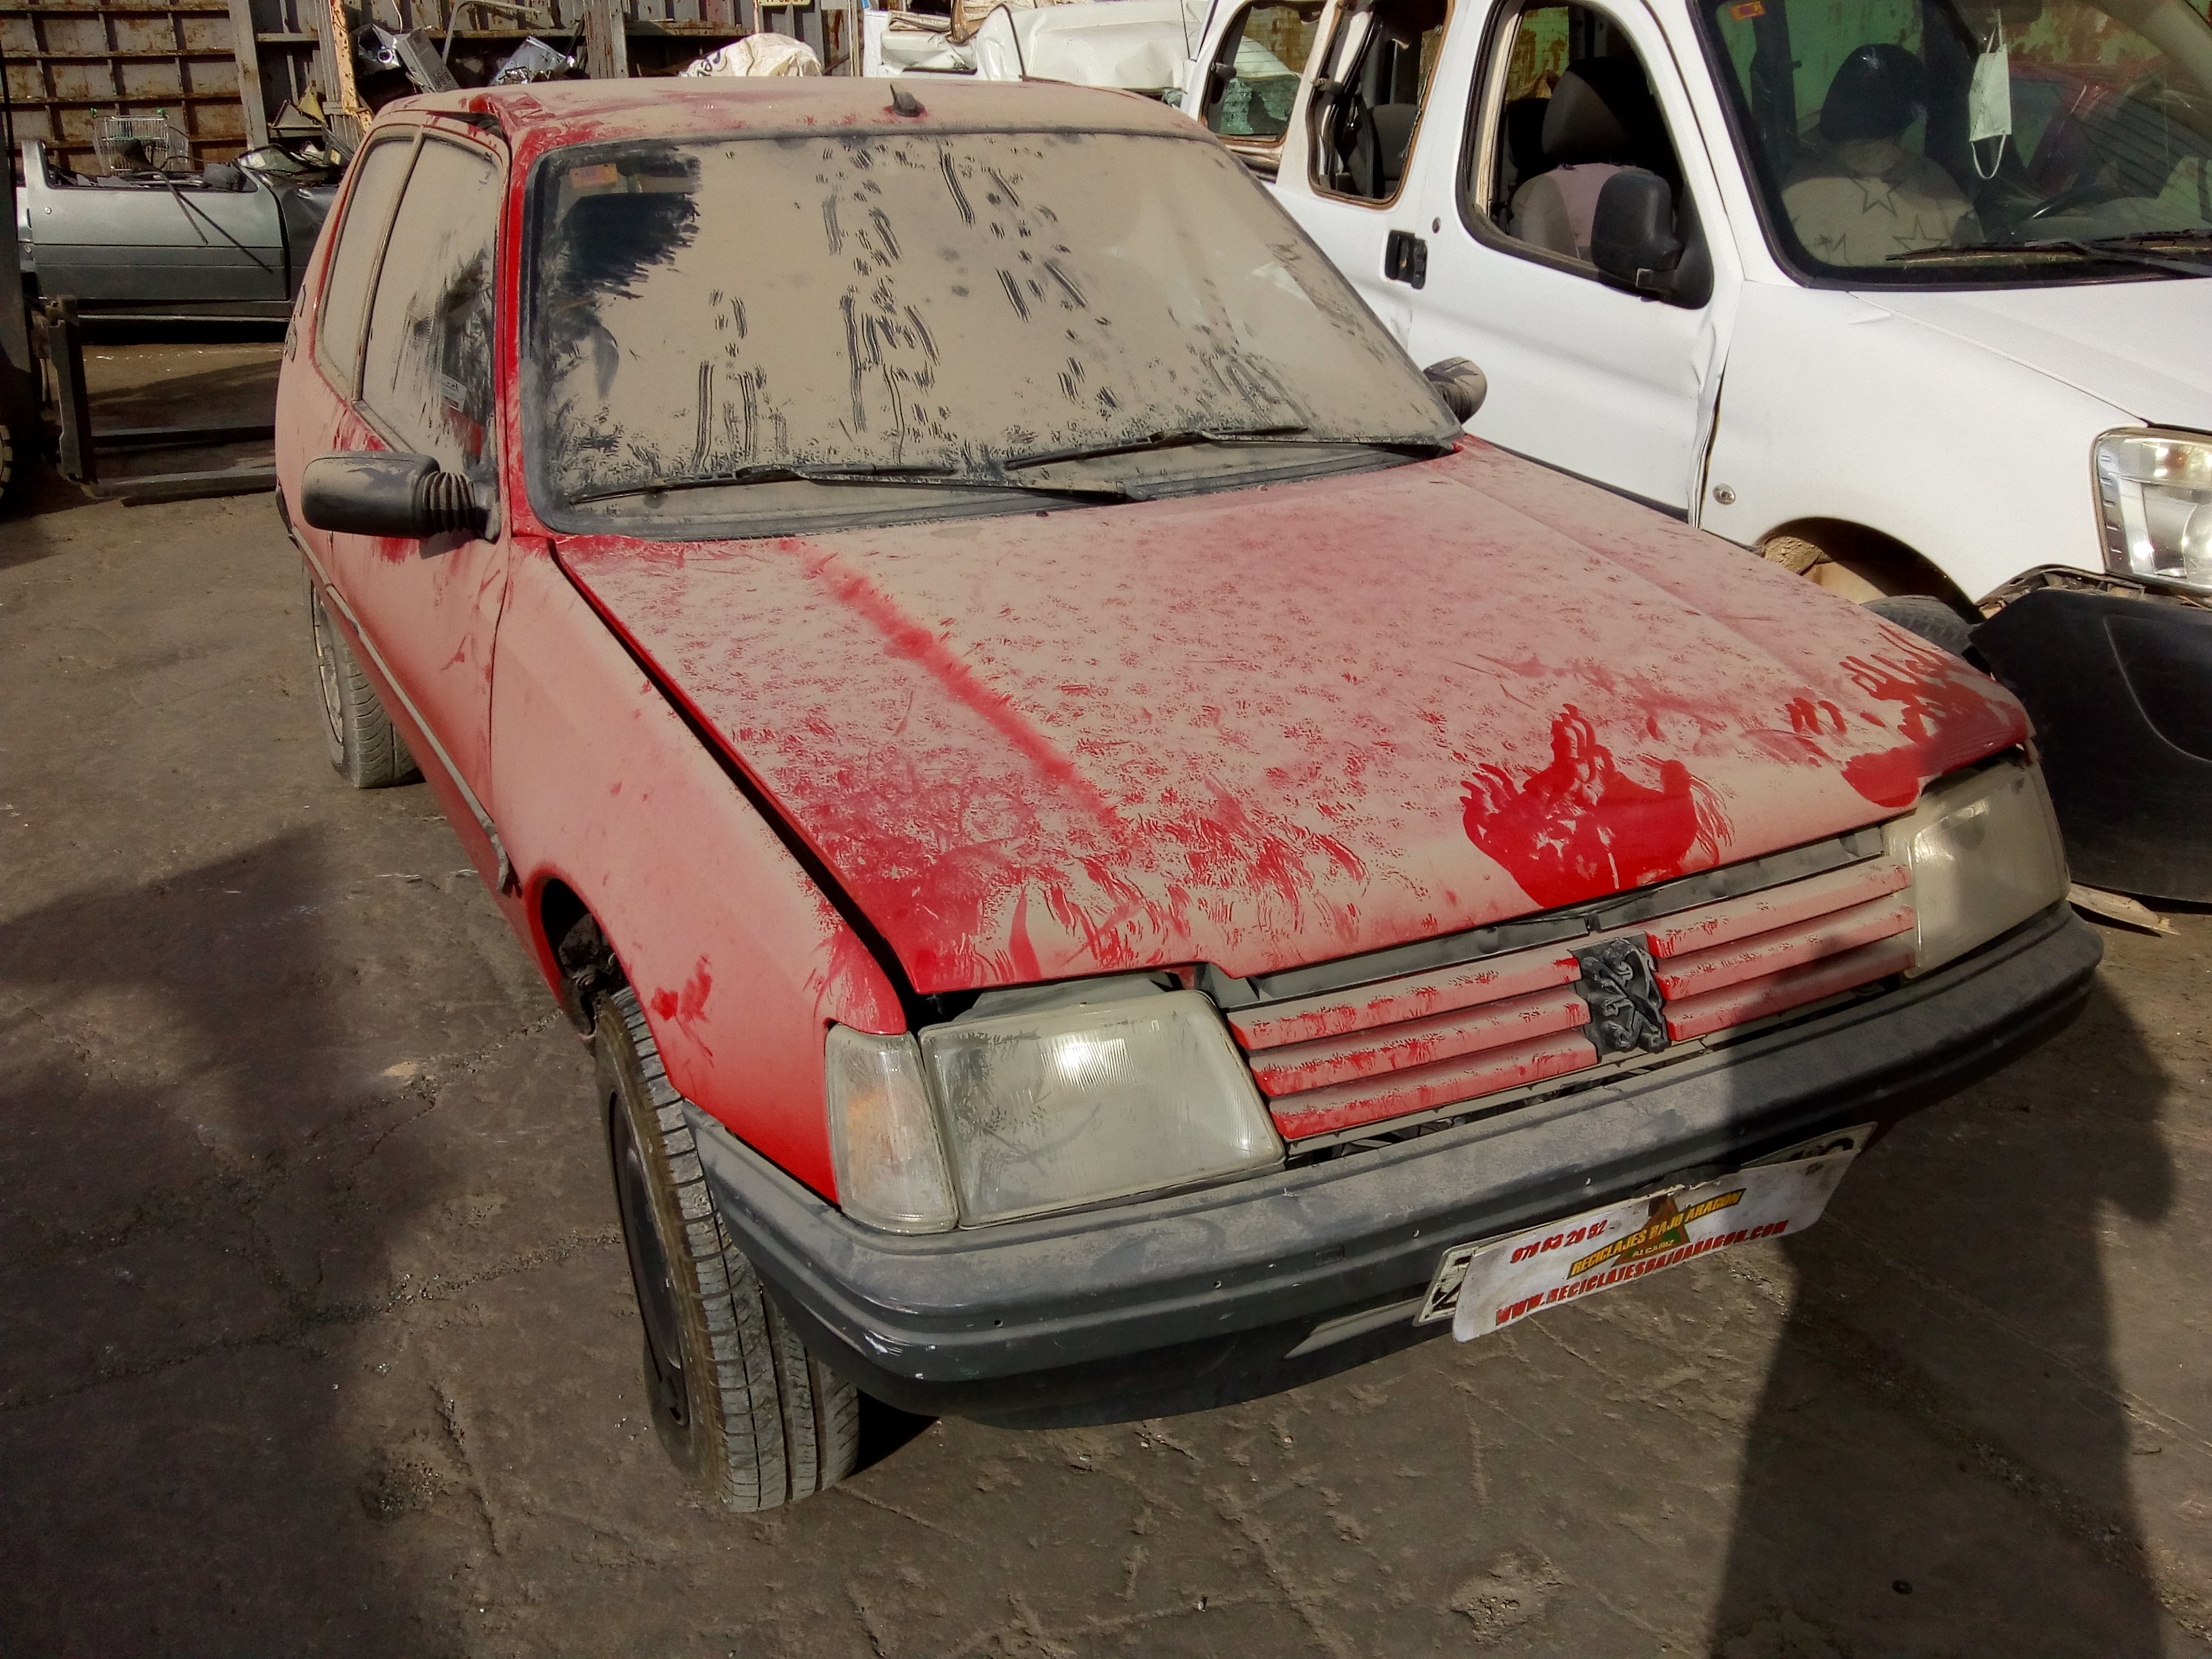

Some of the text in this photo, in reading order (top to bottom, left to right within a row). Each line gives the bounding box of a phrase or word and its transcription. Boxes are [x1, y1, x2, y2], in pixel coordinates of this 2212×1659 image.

[1563, 1227, 1587, 1248] 20
[1587, 1219, 1608, 1240] 52
[1570, 1229, 1648, 1275] RECICLAJES
[1649, 1212, 1684, 1239] BAJO
